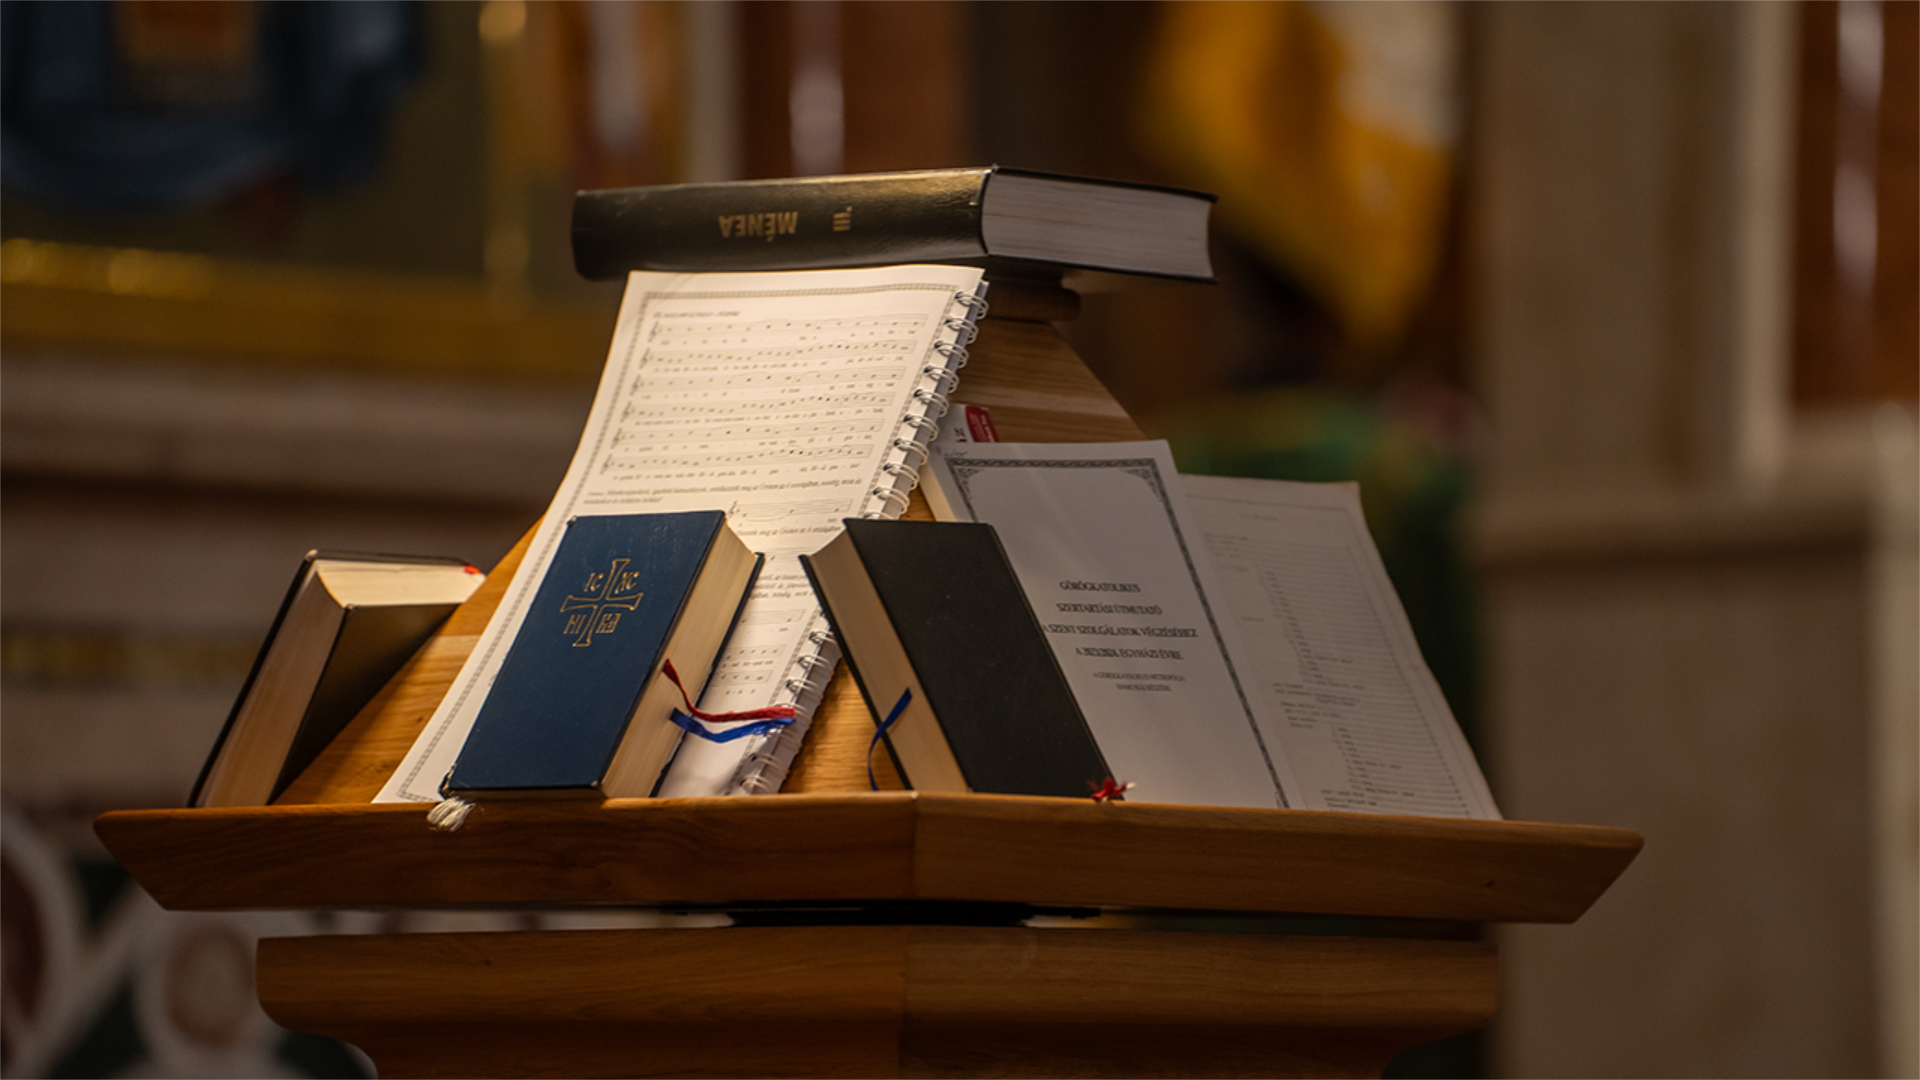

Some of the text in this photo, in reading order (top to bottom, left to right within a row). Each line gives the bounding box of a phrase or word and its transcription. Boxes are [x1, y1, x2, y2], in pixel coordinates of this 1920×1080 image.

[718, 211, 799, 242] MÉNEA
[1059, 580, 1141, 593] GÖRÖGKATOLIKUS
[1056, 602, 1163, 615] SZERTARTÁSI ÚTMUTATÓ
[1048, 624, 1077, 634] SZENT
[1077, 624, 1140, 637] SZOLGÁLATOK
[1140, 626, 1199, 638] VÉGZÉSÉHEZ
[1120, 647, 1159, 659] EGYHÁZI
